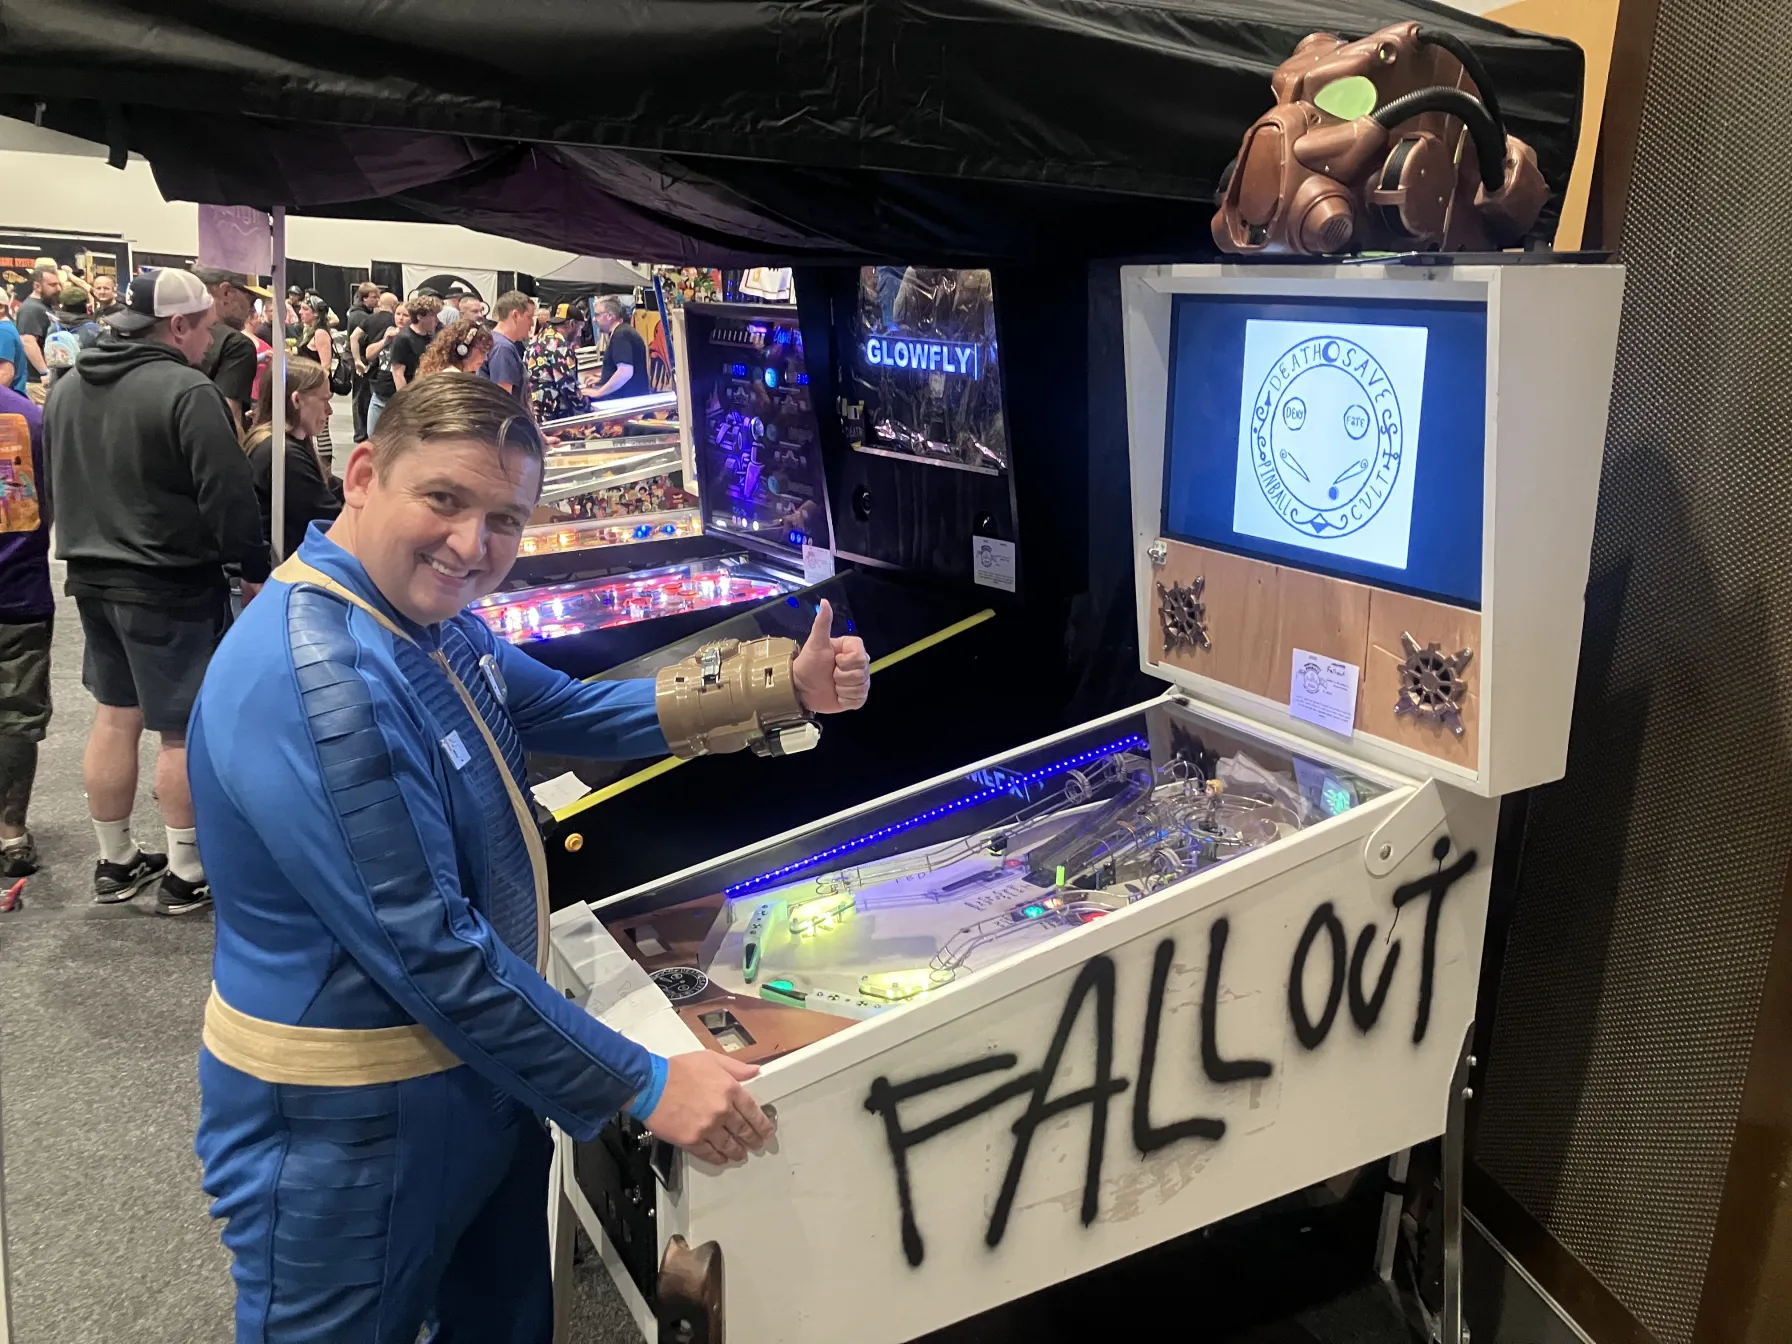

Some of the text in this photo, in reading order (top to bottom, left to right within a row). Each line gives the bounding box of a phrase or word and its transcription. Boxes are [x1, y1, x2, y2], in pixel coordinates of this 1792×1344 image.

[866, 338, 972, 374] GLOWFLY
[1269, 342, 1393, 436] DEATH SAVES
[1257, 459, 1293, 517] PINBALL
